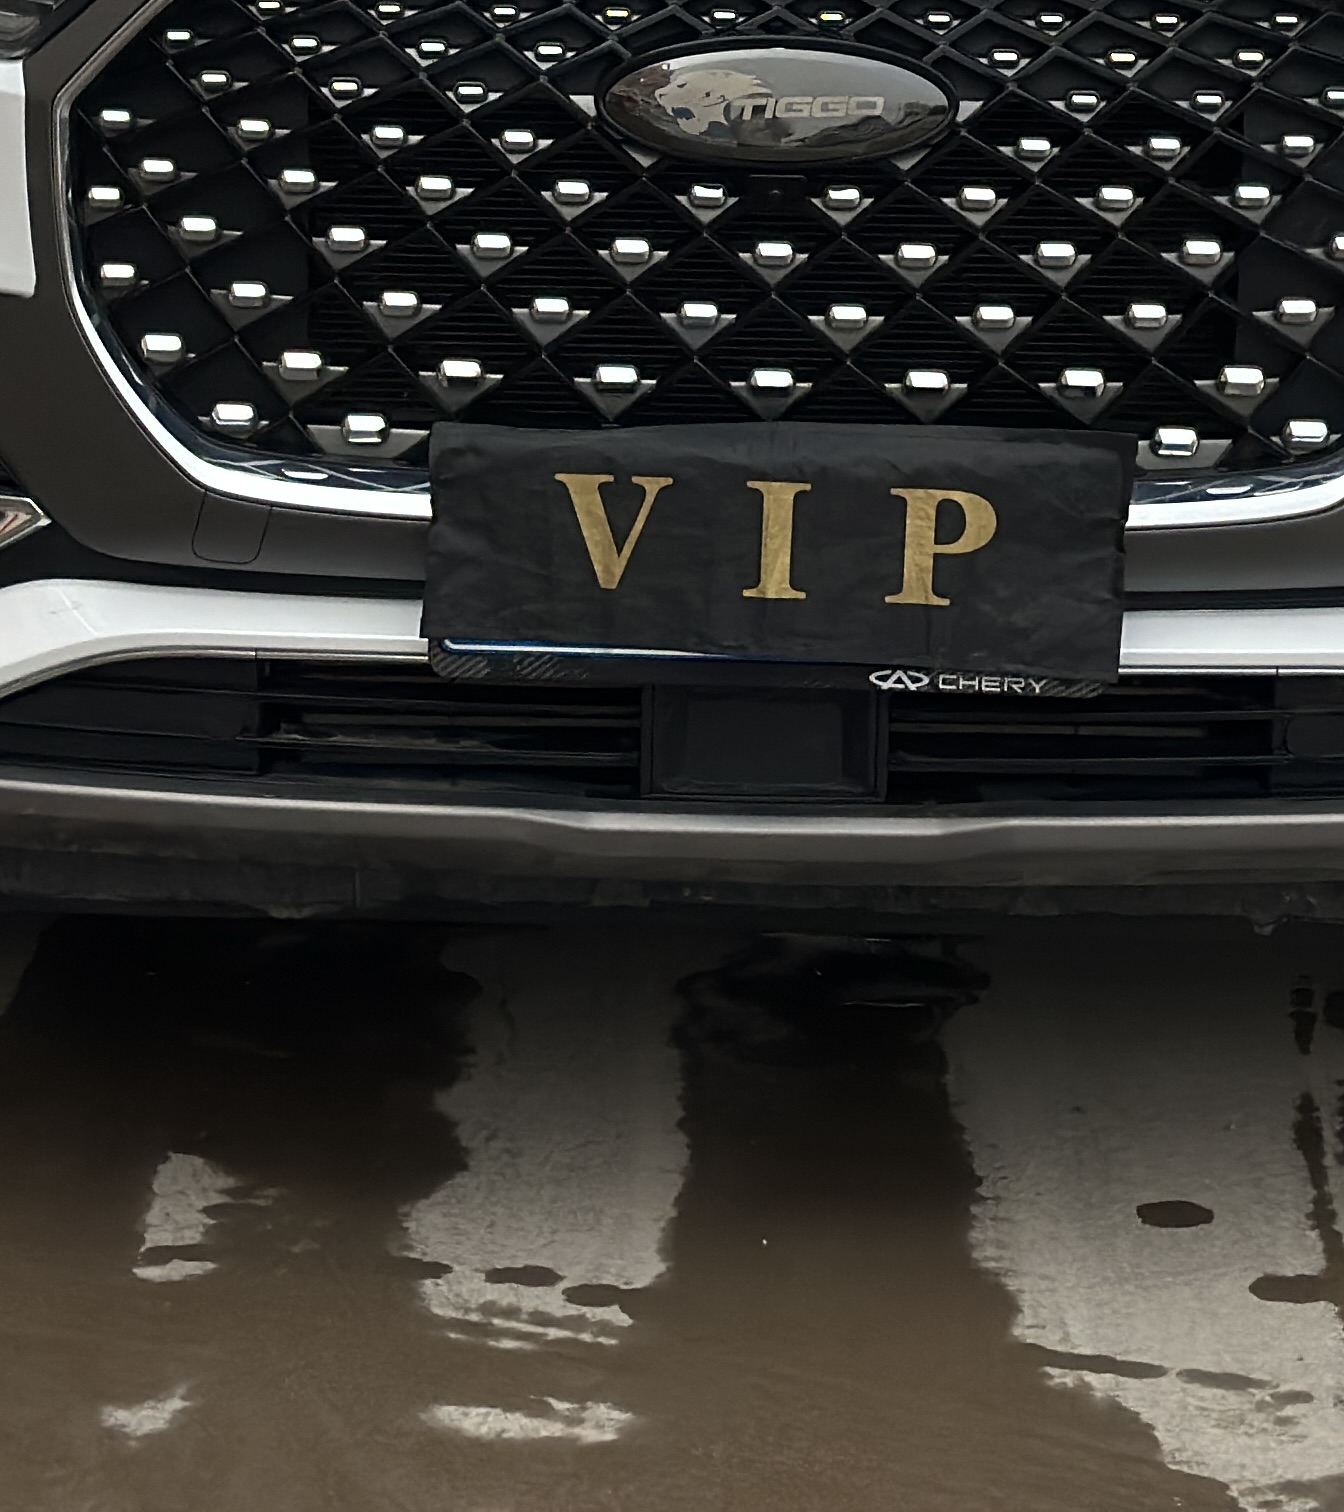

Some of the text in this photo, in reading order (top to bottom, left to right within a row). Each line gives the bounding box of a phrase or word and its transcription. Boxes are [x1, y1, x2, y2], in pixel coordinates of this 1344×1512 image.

[730, 96, 885, 121] TIGGO
[555, 473, 998, 607] VIP
[938, 673, 1047, 694] CHERY
